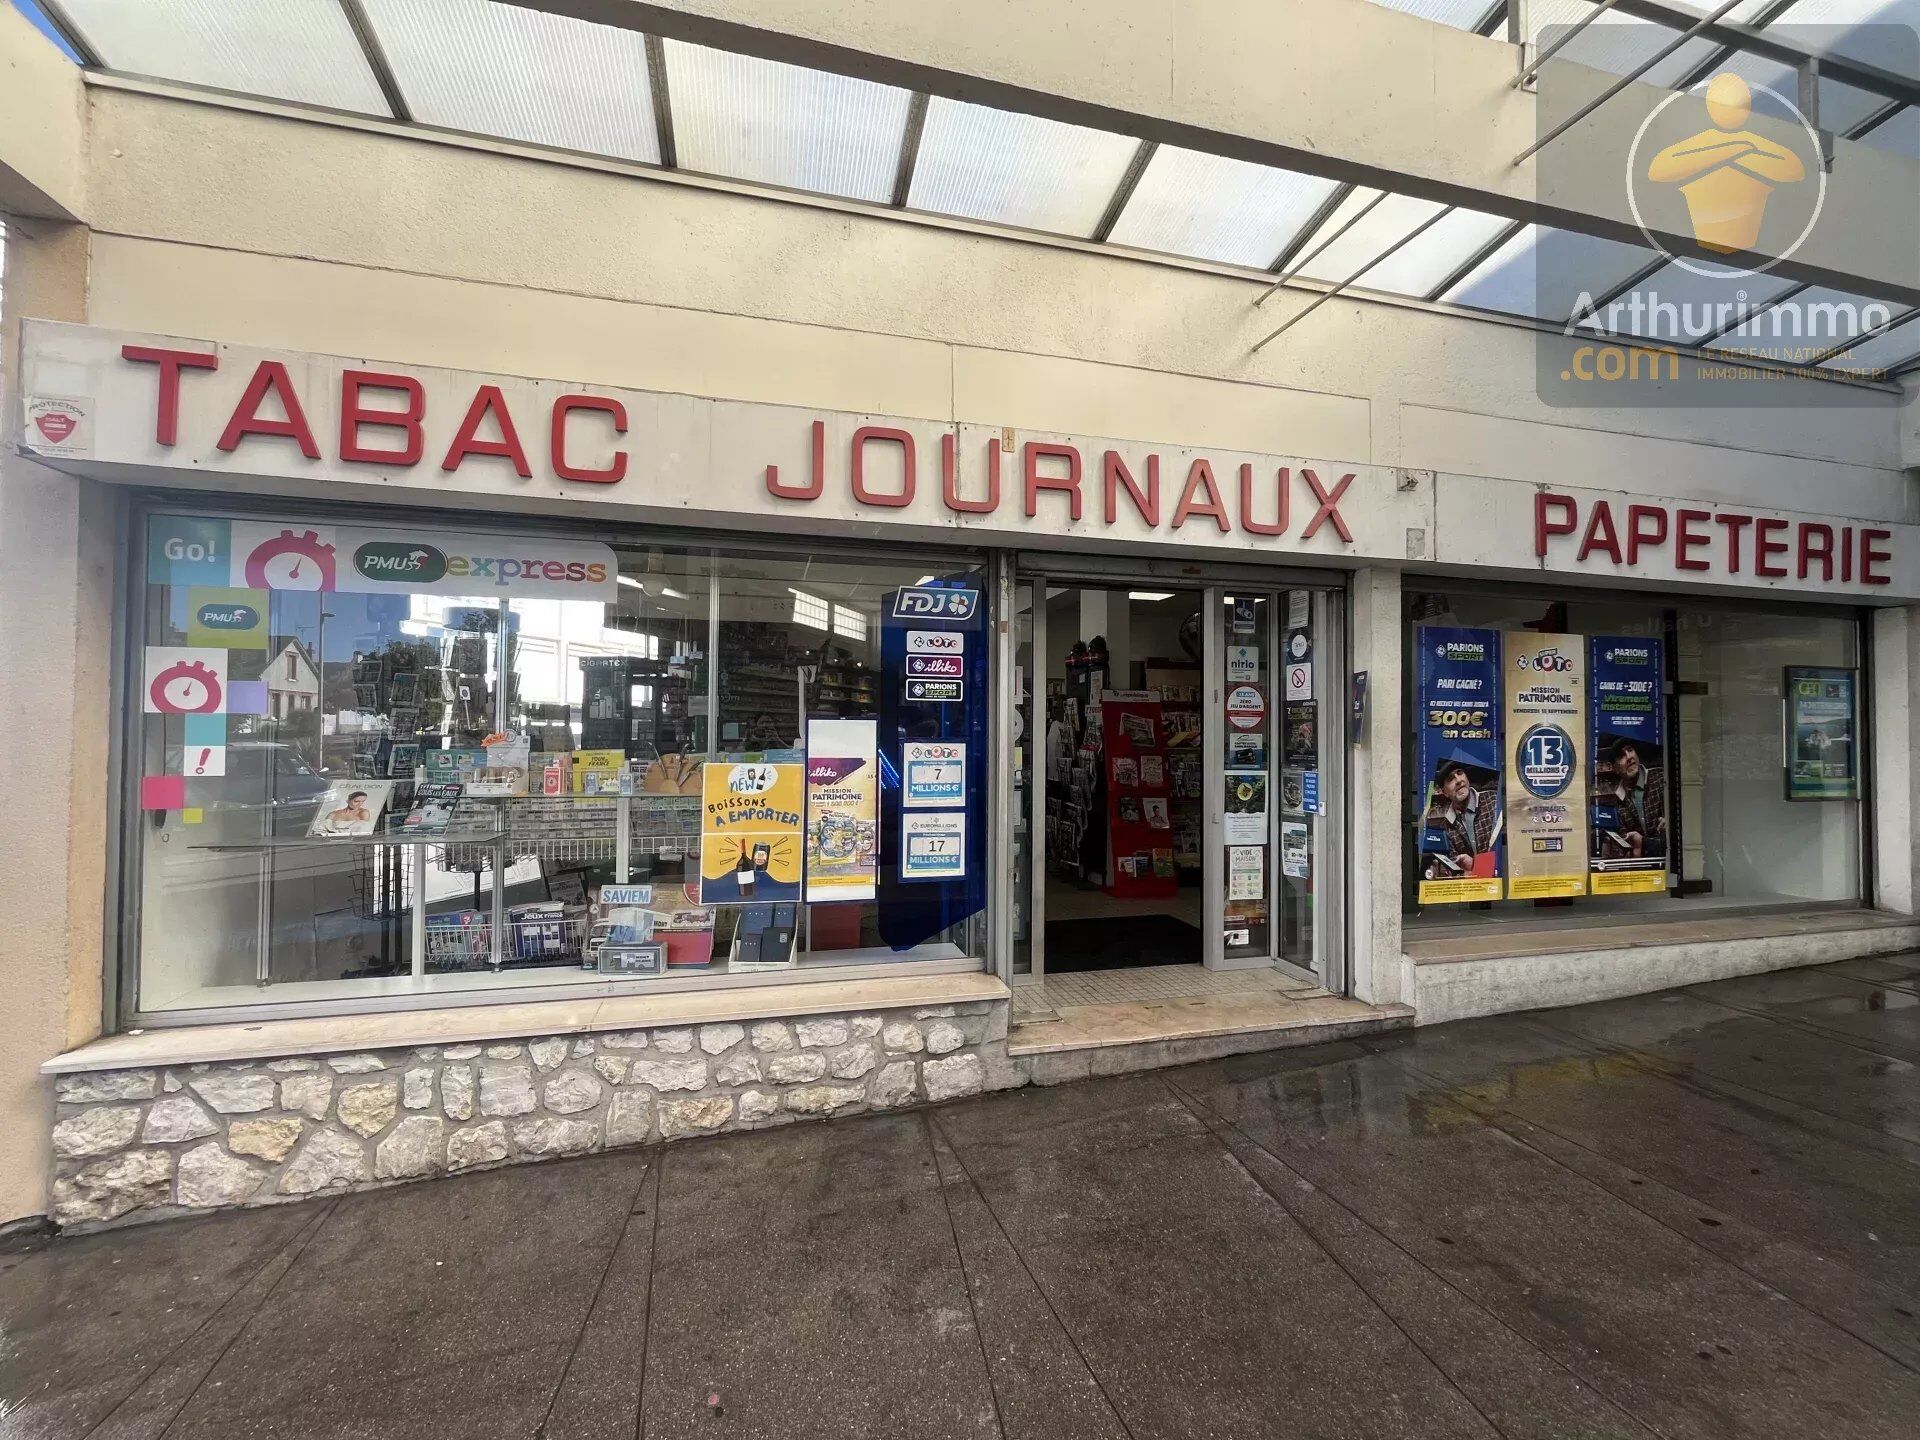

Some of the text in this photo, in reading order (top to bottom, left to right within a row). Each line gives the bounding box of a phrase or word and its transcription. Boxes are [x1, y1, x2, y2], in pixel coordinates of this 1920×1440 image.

[121, 344, 1357, 543] TABAC JOURNAUX
[1534, 493, 1892, 585] PAPETERIE
[163, 536, 216, 563] Go!
[363, 553, 608, 586] PMU express
[900, 592, 947, 613] FDJ
[203, 611, 232, 624] PMU
[926, 636, 958, 648] LOTO
[1447, 642, 1484, 653] PARIONS
[1448, 652, 1484, 660] SPORT
[1614, 648, 1648, 657] PARIONS
[924, 659, 957, 673] illiko
[1231, 659, 1255, 669] nirio
[1533, 655, 1574, 672] LOTO
[1437, 679, 1483, 690] PARI GAGNÉ ?
[1518, 693, 1572, 703] PATRIMOINE
[1442, 728, 1492, 739] en cash
[924, 746, 958, 759] LOTO
[1527, 735, 1564, 767] 13
[809, 766, 837, 777] illiko
[934, 768, 942, 780] 7
[1526, 766, 1560, 774] MILLIONS
[911, 784, 959, 792] MILLIONS €
[812, 793, 863, 801] PATRIMOINE
[728, 807, 800, 827] EMPORTER
[928, 840, 946, 852] 17
[909, 856, 950, 864] MILLIONS
[602, 888, 650, 903] SAVIEM
